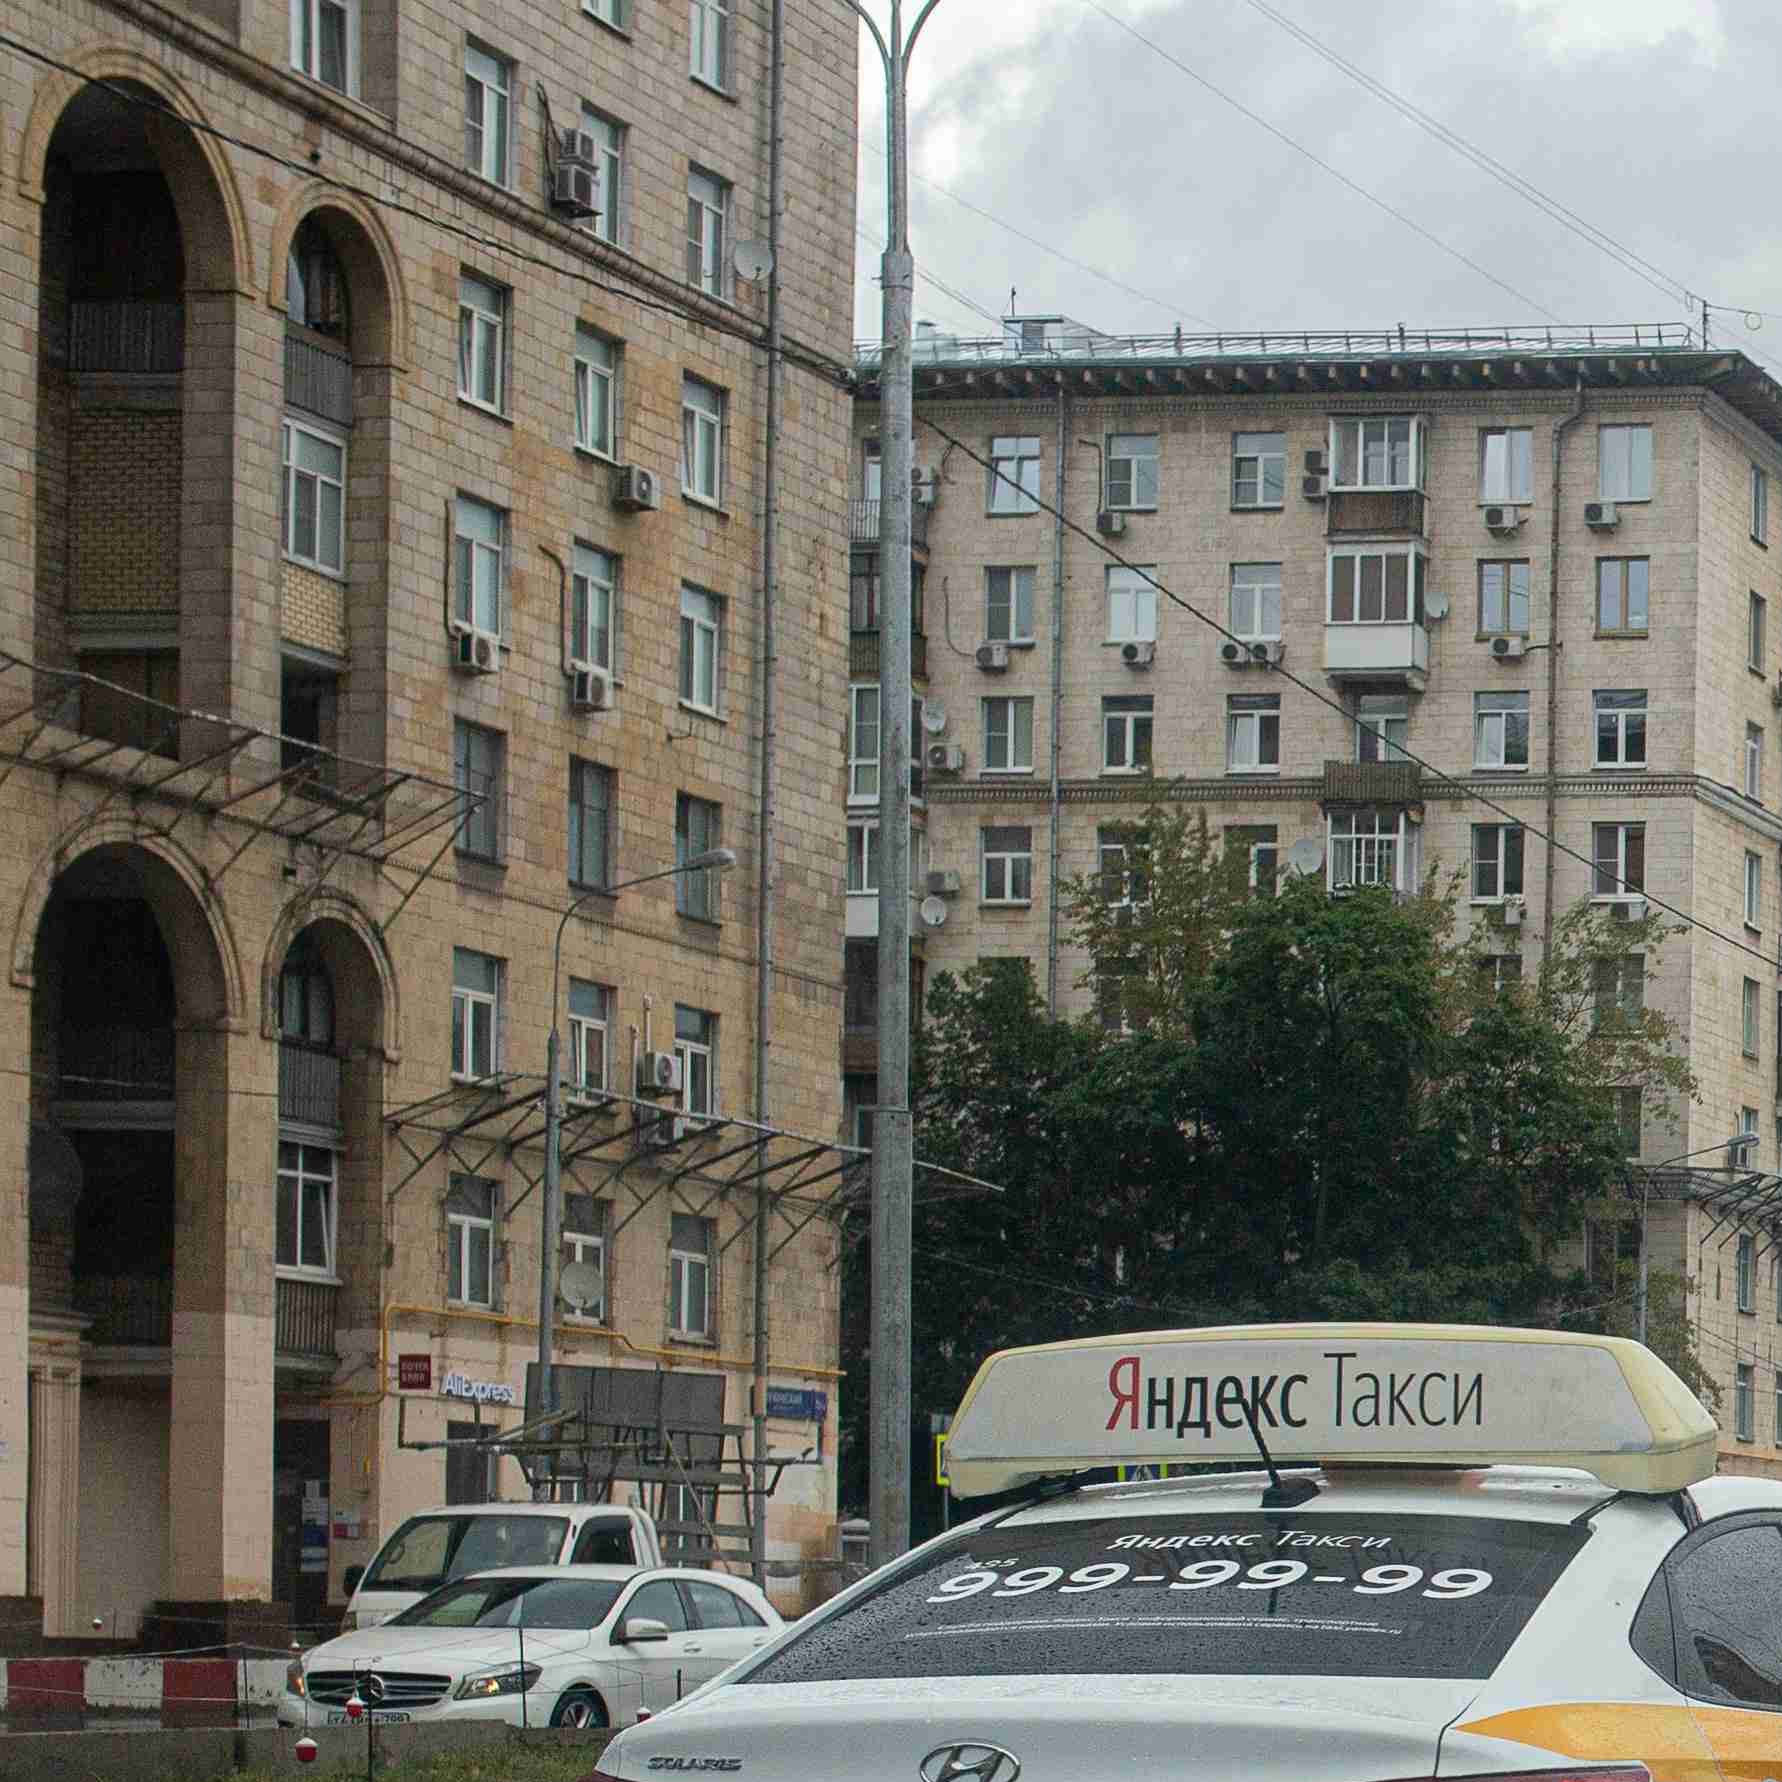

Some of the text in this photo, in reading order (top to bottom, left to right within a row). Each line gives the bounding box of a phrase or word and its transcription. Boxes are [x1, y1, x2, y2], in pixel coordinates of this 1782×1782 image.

[1106, 1352, 1484, 1439] Яндекс Такси
[1106, 1530, 1393, 1551] Яндекс Такси
[925, 1559, 1494, 1603] 999-99-99
[646, 1757, 743, 1771] SOLARIS
